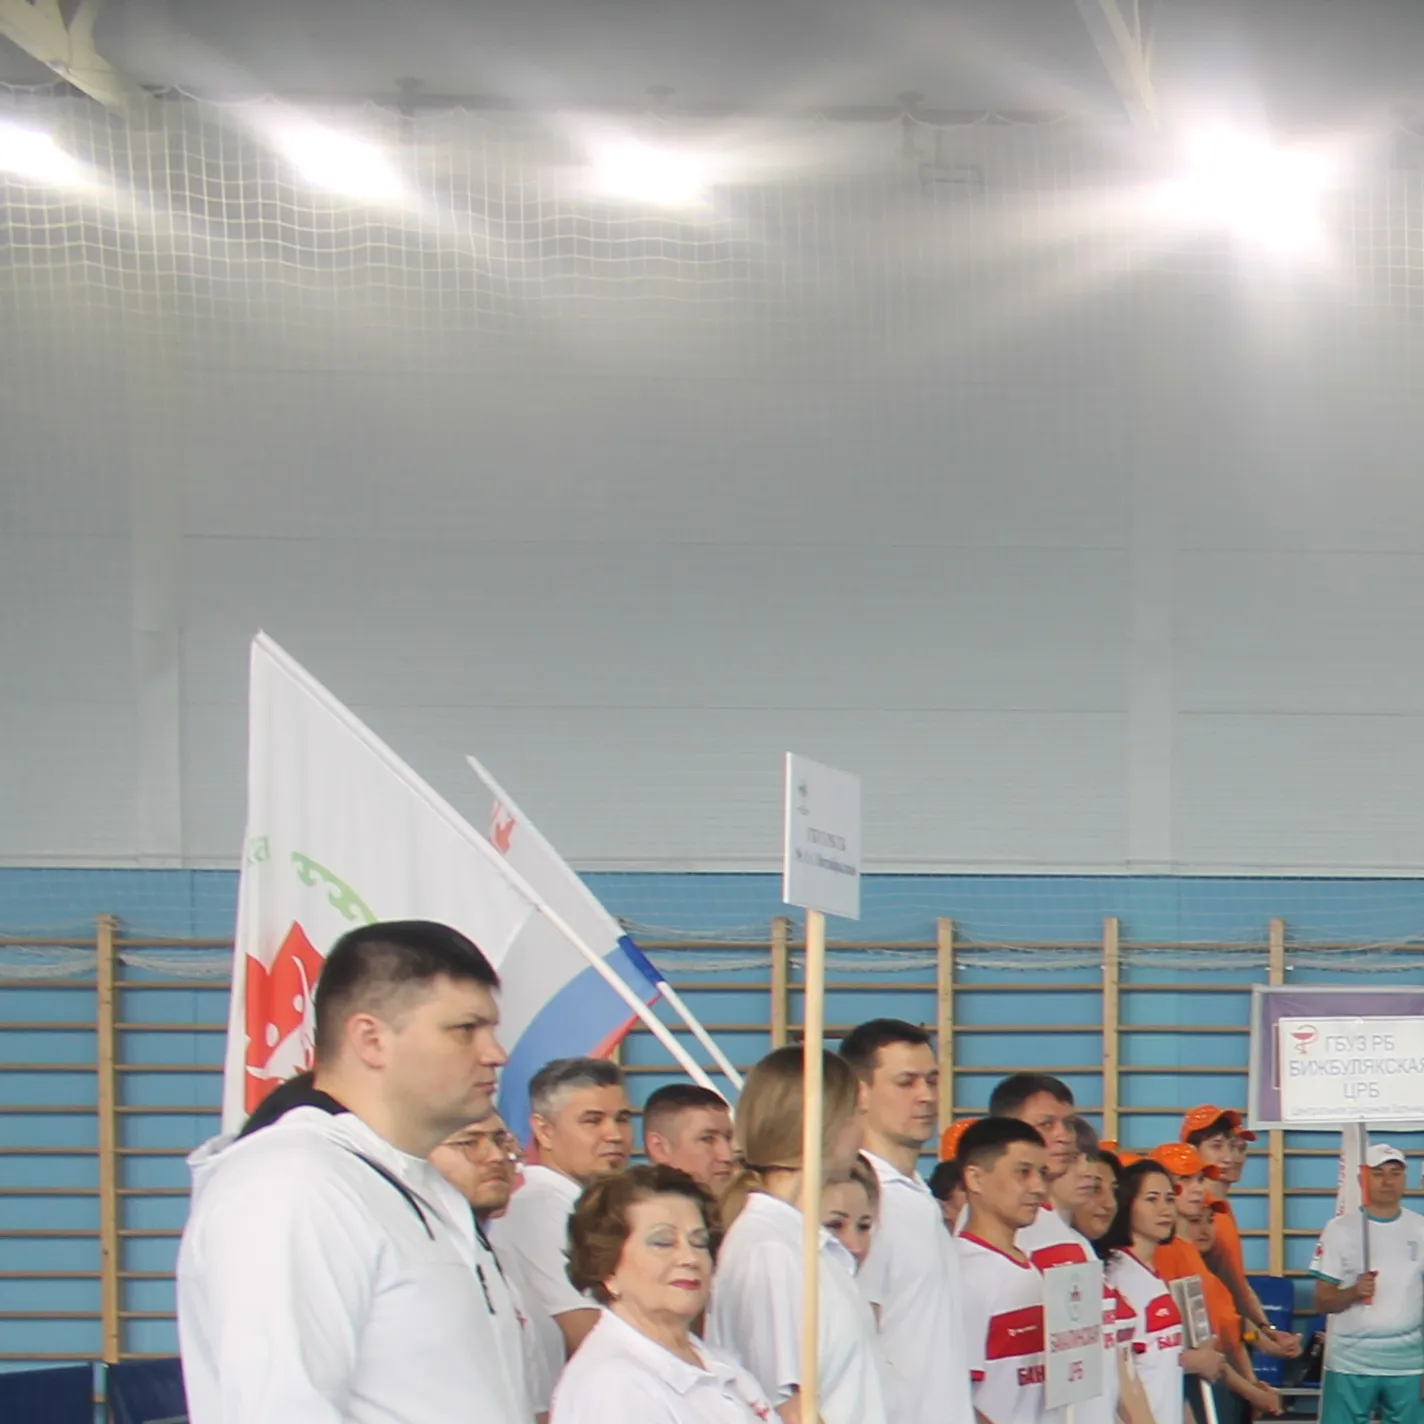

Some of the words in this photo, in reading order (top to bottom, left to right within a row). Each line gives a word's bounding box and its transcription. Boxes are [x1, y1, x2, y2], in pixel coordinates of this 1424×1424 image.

[1325, 1035, 1368, 1052] ГБУЗ
[1372, 1035, 1395, 1051] РБ
[1344, 1082, 1380, 1101] ЦРБ
